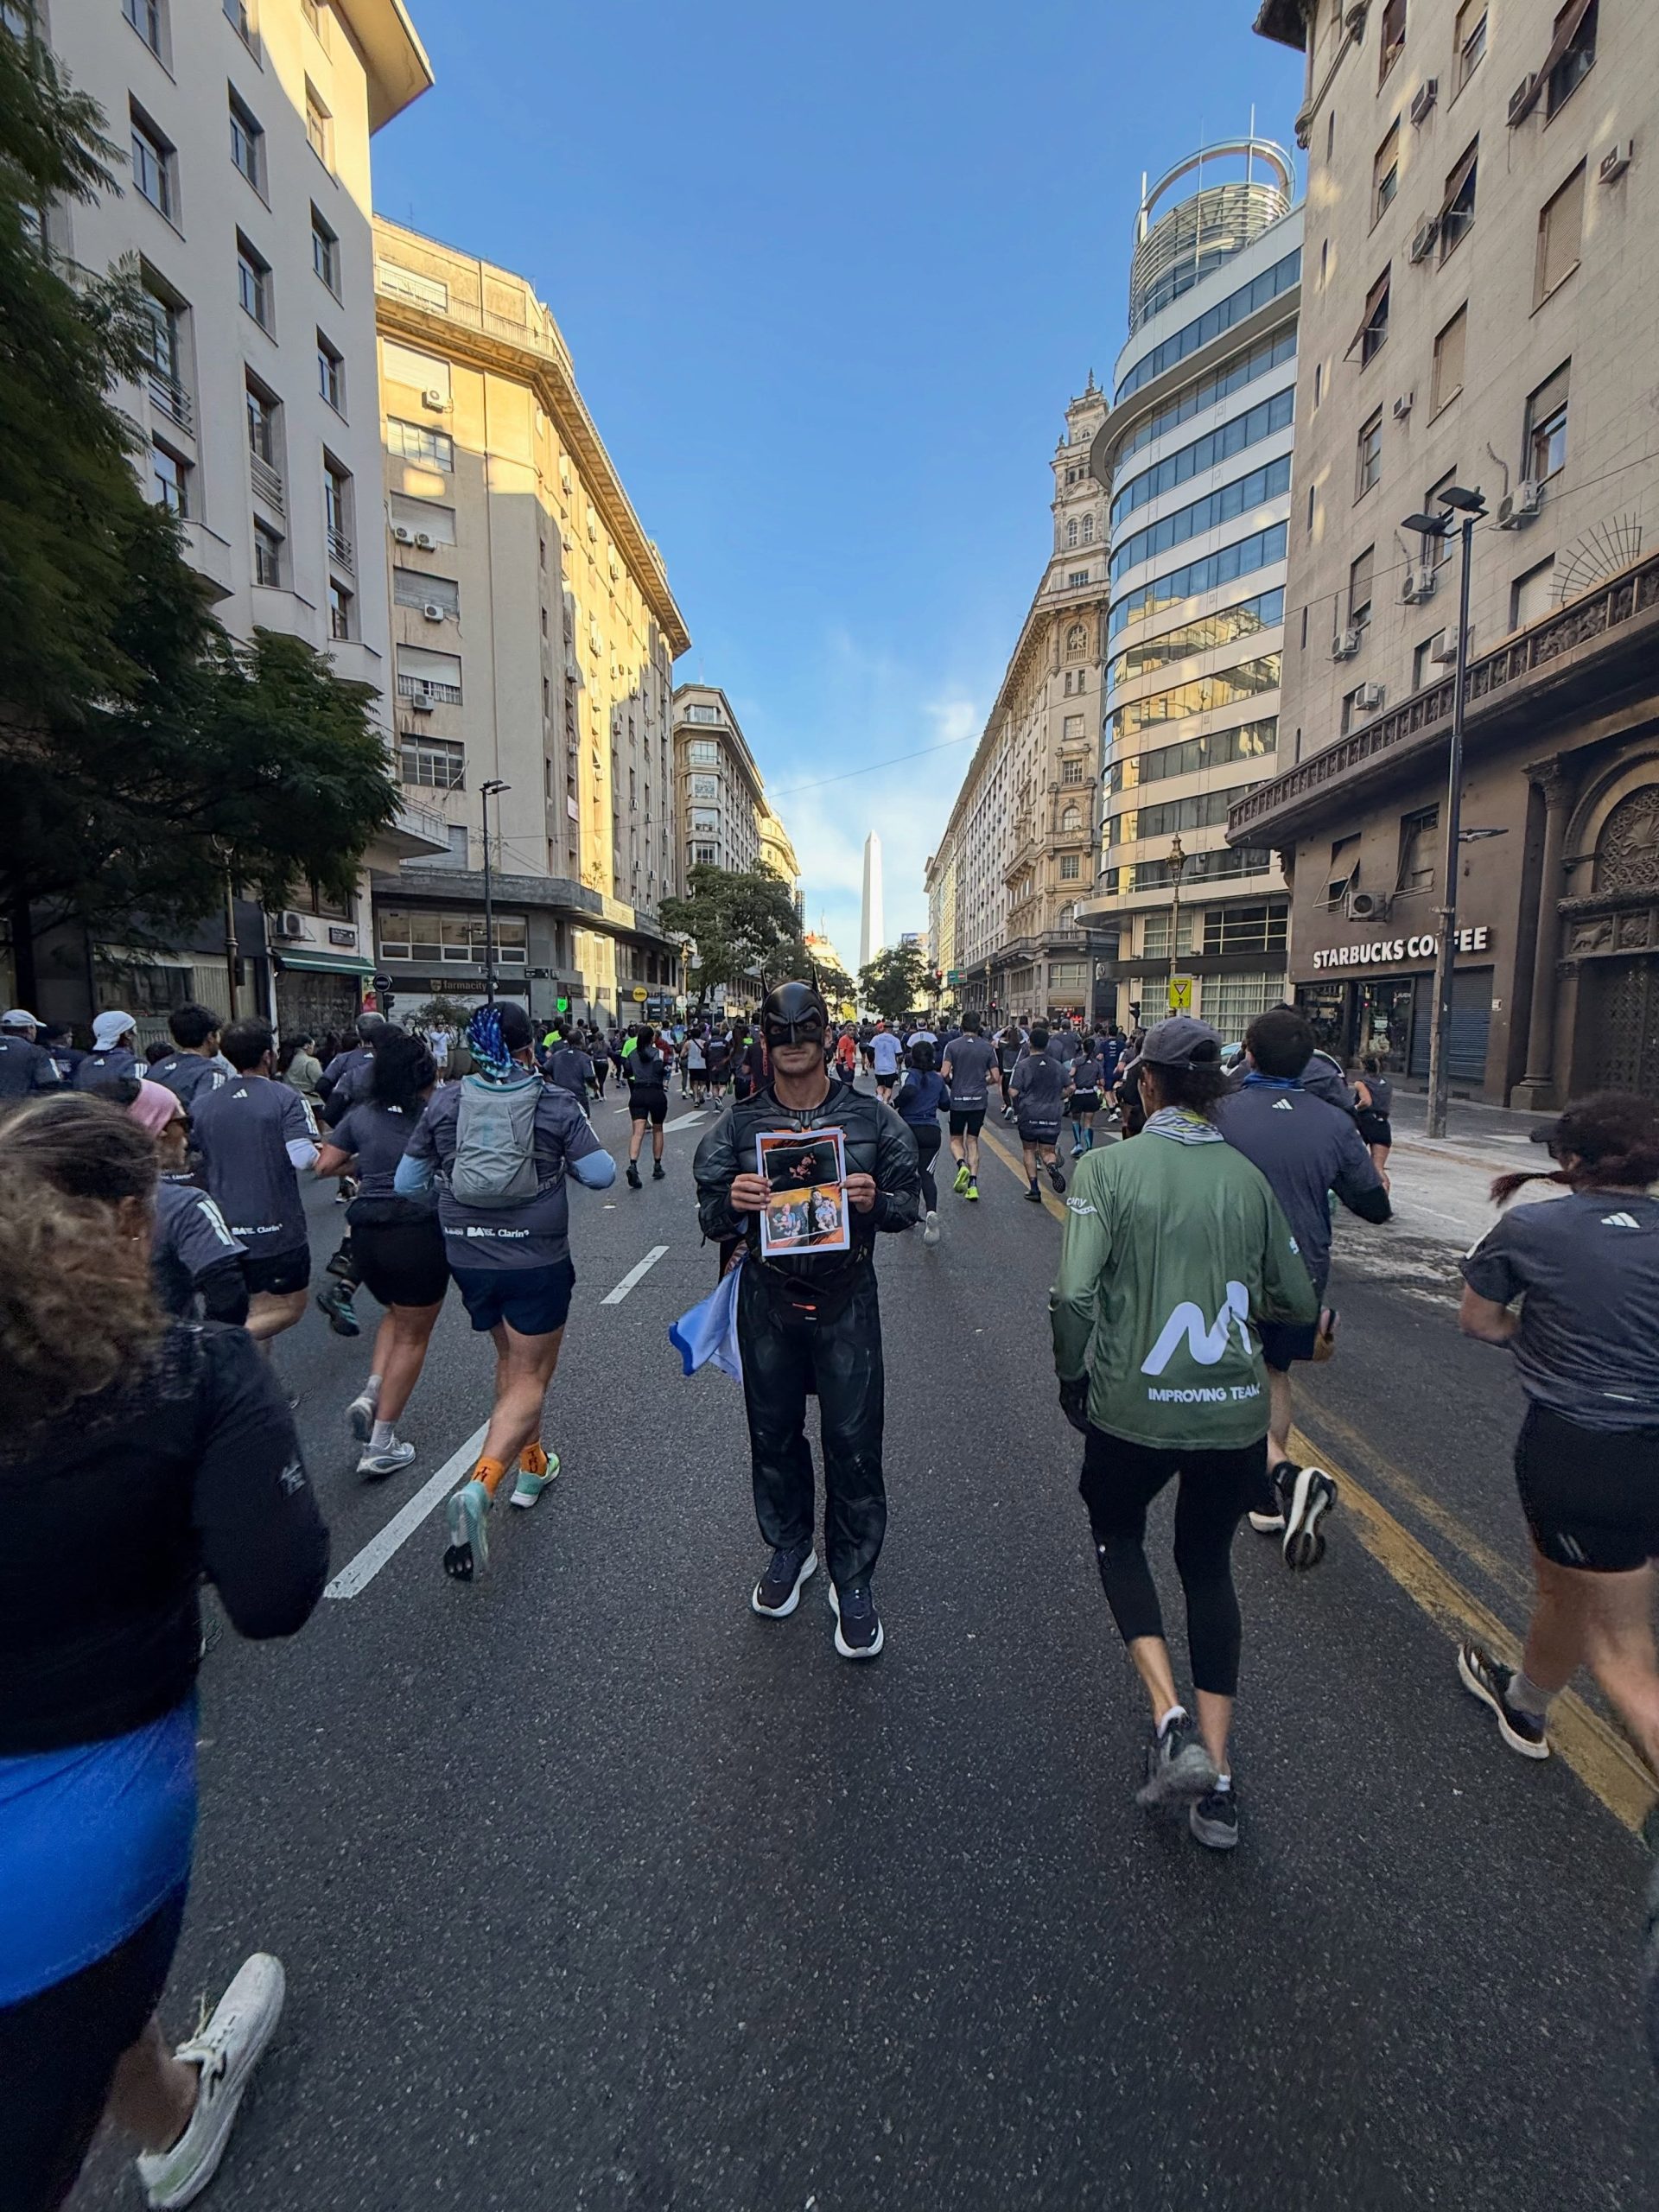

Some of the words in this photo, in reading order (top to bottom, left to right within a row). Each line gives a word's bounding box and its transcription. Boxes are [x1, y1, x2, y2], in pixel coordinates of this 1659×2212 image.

[1313, 938, 1404, 969] STARBUCKS
[1407, 925, 1488, 958] COEE
[442, 979, 487, 995] farmacity
[1147, 1387, 1227, 1403] IMPROVING
